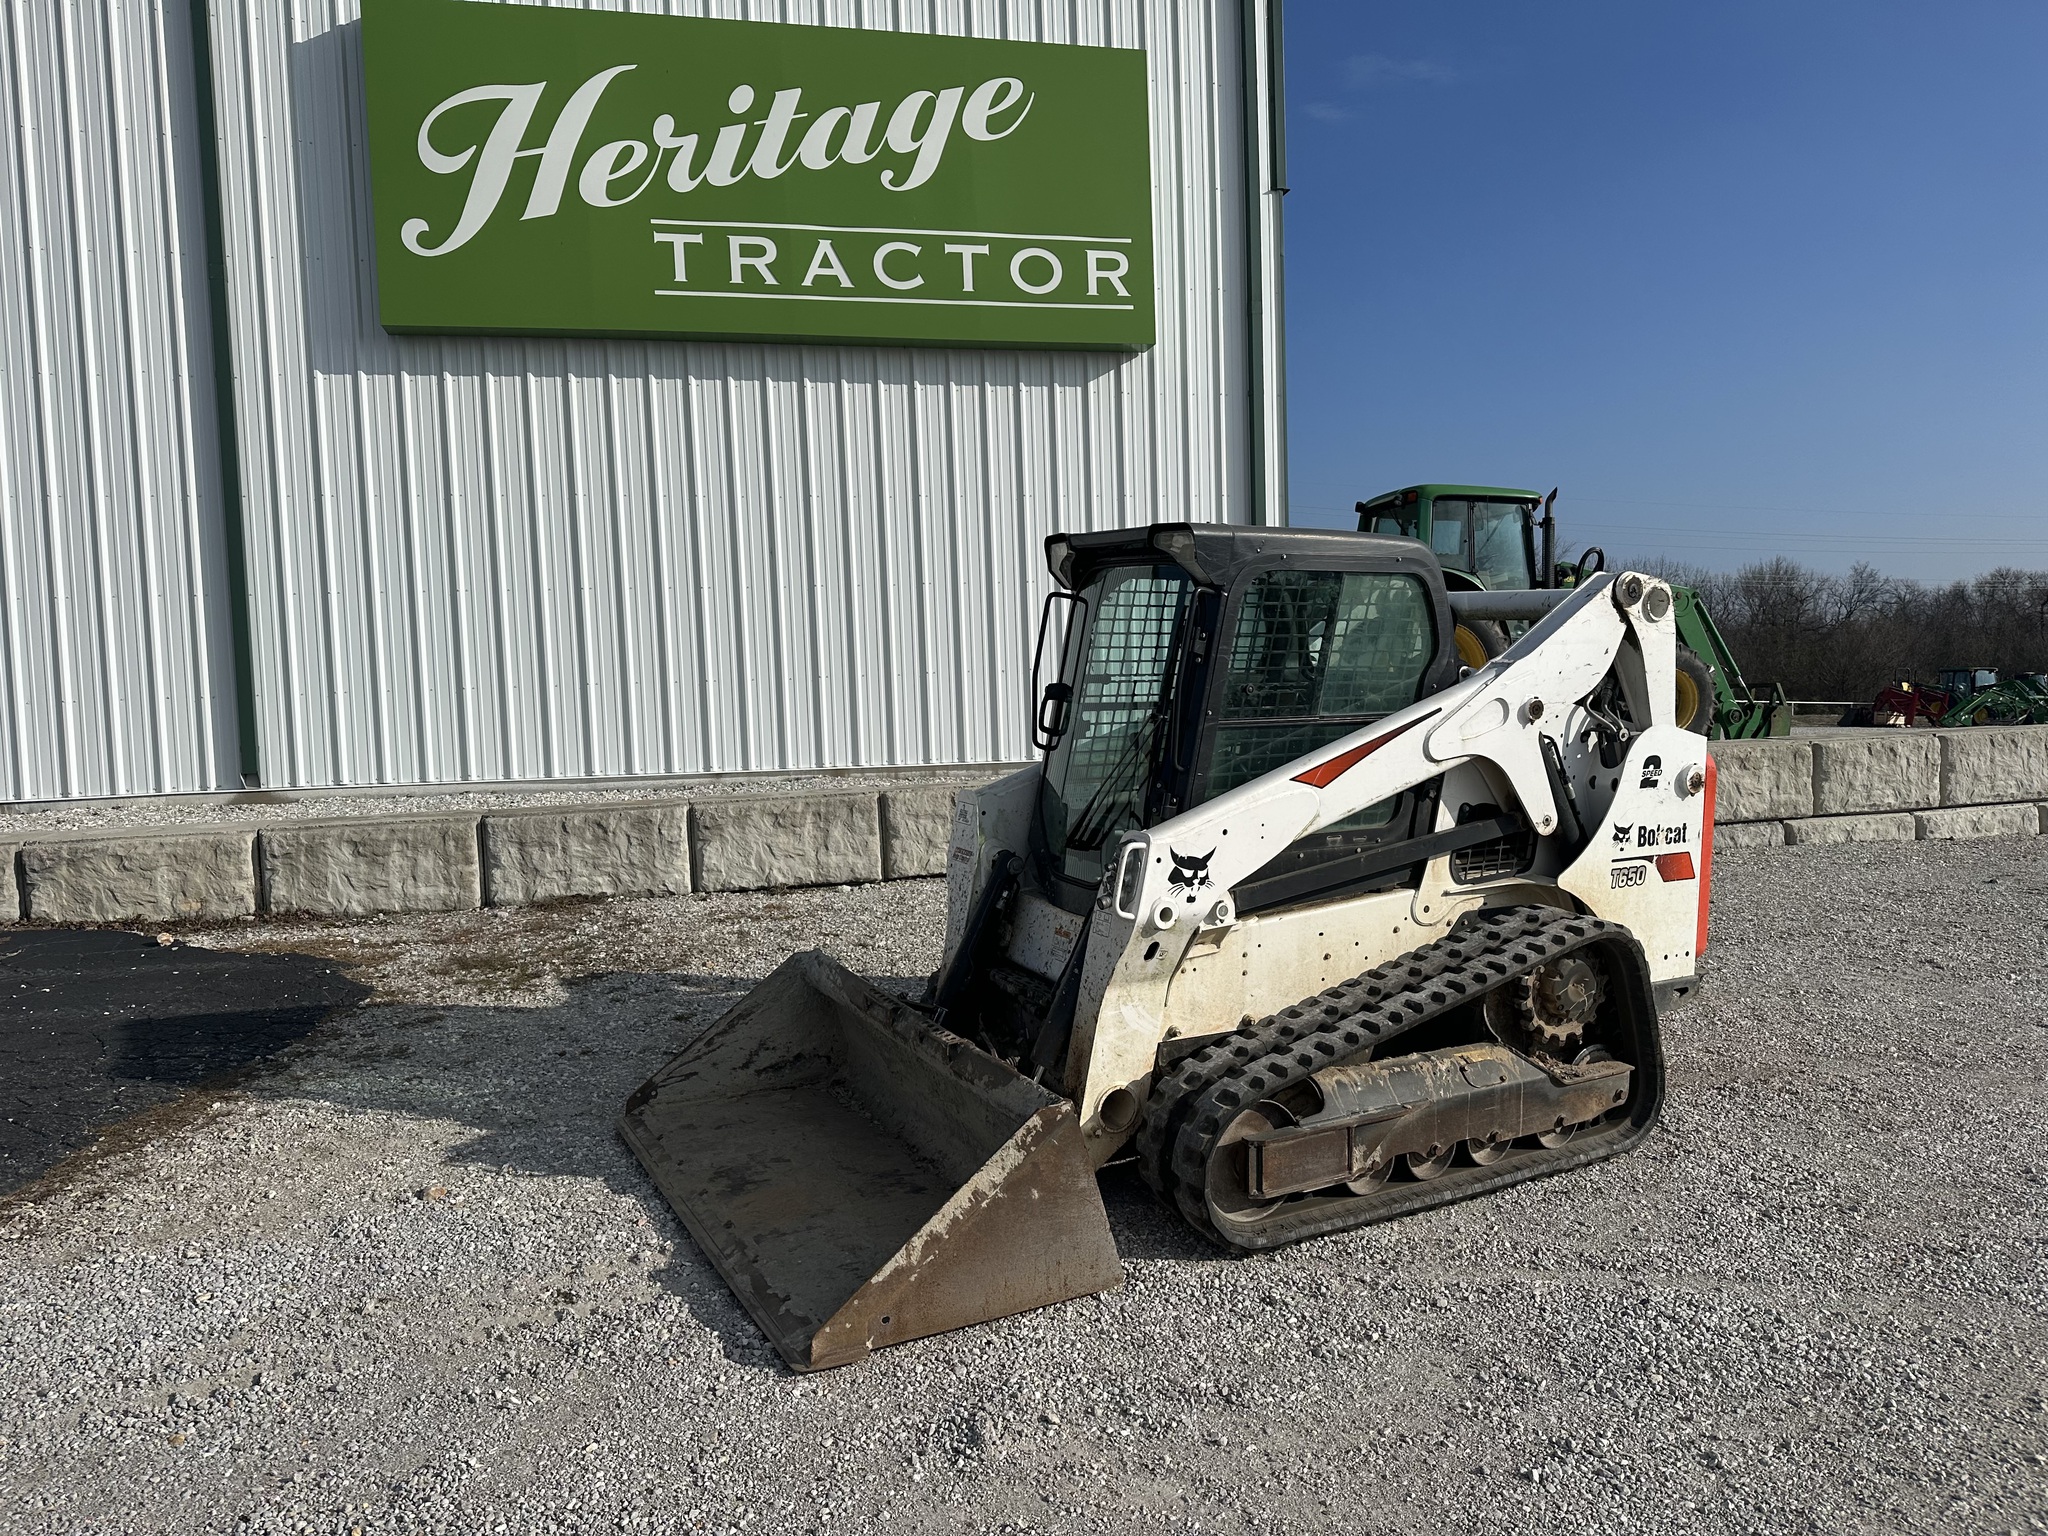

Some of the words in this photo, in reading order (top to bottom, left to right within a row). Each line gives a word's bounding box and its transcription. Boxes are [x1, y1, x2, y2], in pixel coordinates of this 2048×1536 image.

[401, 65, 1034, 256] Heritage
[653, 231, 1131, 297] TRACTOR
[1639, 755, 1661, 789] 2
[1641, 769, 1663, 777] SPEED
[1611, 865, 1646, 889] T650
